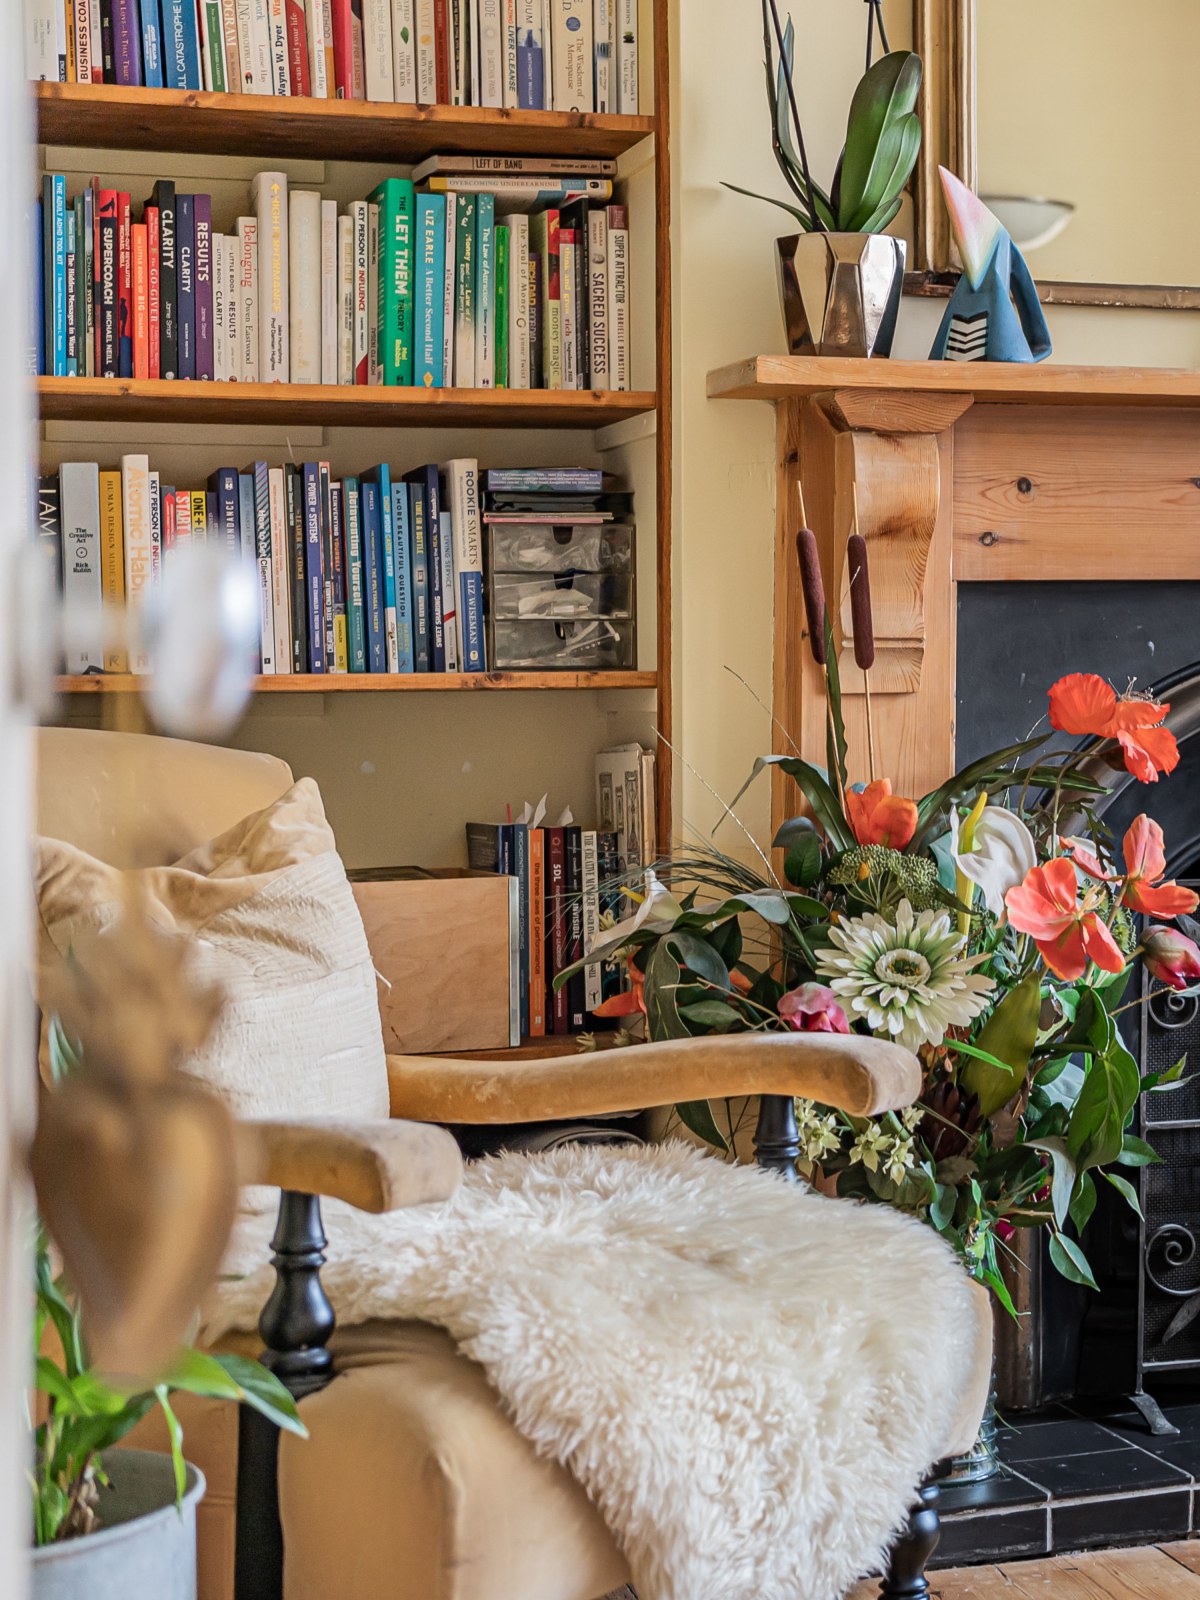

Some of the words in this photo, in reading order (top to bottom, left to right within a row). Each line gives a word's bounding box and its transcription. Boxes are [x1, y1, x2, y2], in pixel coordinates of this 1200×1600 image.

[322, 1, 331, 39] METHOD
[173, 5, 186, 72] CATASTROPHE
[275, 25, 284, 48] Dyer
[78, 26, 88, 80] BUSINESS
[566, 43, 575, 89] Menopause
[278, 66, 287, 95] Wayne
[577, 88, 584, 98] of
[476, 159, 490, 169] LEFT
[493, 159, 501, 169] OF
[505, 160, 523, 170] BANG
[395, 214, 408, 243] LET
[425, 209, 434, 226] LIZ
[162, 209, 174, 268] CLARITY
[198, 222, 209, 281] RESULTS
[425, 230, 434, 263] EARLE
[614, 235, 625, 258] SUPER
[67, 254, 75, 267] The
[103, 227, 114, 305] SUPERCOACH
[181, 246, 190, 293] CLARITY
[241, 224, 256, 288] Belonging
[359, 258, 365, 268] OF
[396, 248, 408, 294] THEM
[483, 260, 490, 268] of
[521, 269, 528, 279] of
[615, 261, 625, 304] ATTRACTOR
[67, 294, 75, 326] Messages
[150, 268, 158, 322] GO-GIVER
[519, 283, 527, 316] Money
[593, 273, 606, 317] SACRED
[551, 307, 559, 342] money
[551, 345, 561, 377] magic
[593, 321, 606, 374] SUCCESS
[107, 480, 116, 512] HUMAN
[128, 467, 148, 540] Atomic
[194, 497, 204, 516] ONE
[308, 482, 318, 505] POWER
[415, 501, 423, 516] TIME
[466, 470, 476, 516] ROOKIE
[39, 500, 57, 536] AM
[176, 495, 190, 534] START
[258, 509, 266, 529] How
[309, 513, 319, 543] SYSTEMS
[348, 490, 360, 557] Reinventing
[416, 516, 423, 524] IN
[108, 516, 117, 549] DESIGN
[152, 532, 158, 543] OF
[259, 531, 267, 541] to
[468, 519, 477, 565] SMARTS
[259, 542, 267, 558] Get
[259, 559, 268, 588] Clients
[351, 561, 362, 606] Yourself
[467, 578, 475, 595] LIZ
[468, 596, 477, 644] WISEMAN
[585, 834, 595, 846] THE
[553, 863, 561, 883] SDL
[585, 848, 596, 878] CREATIVE
[535, 917, 541, 926] of
